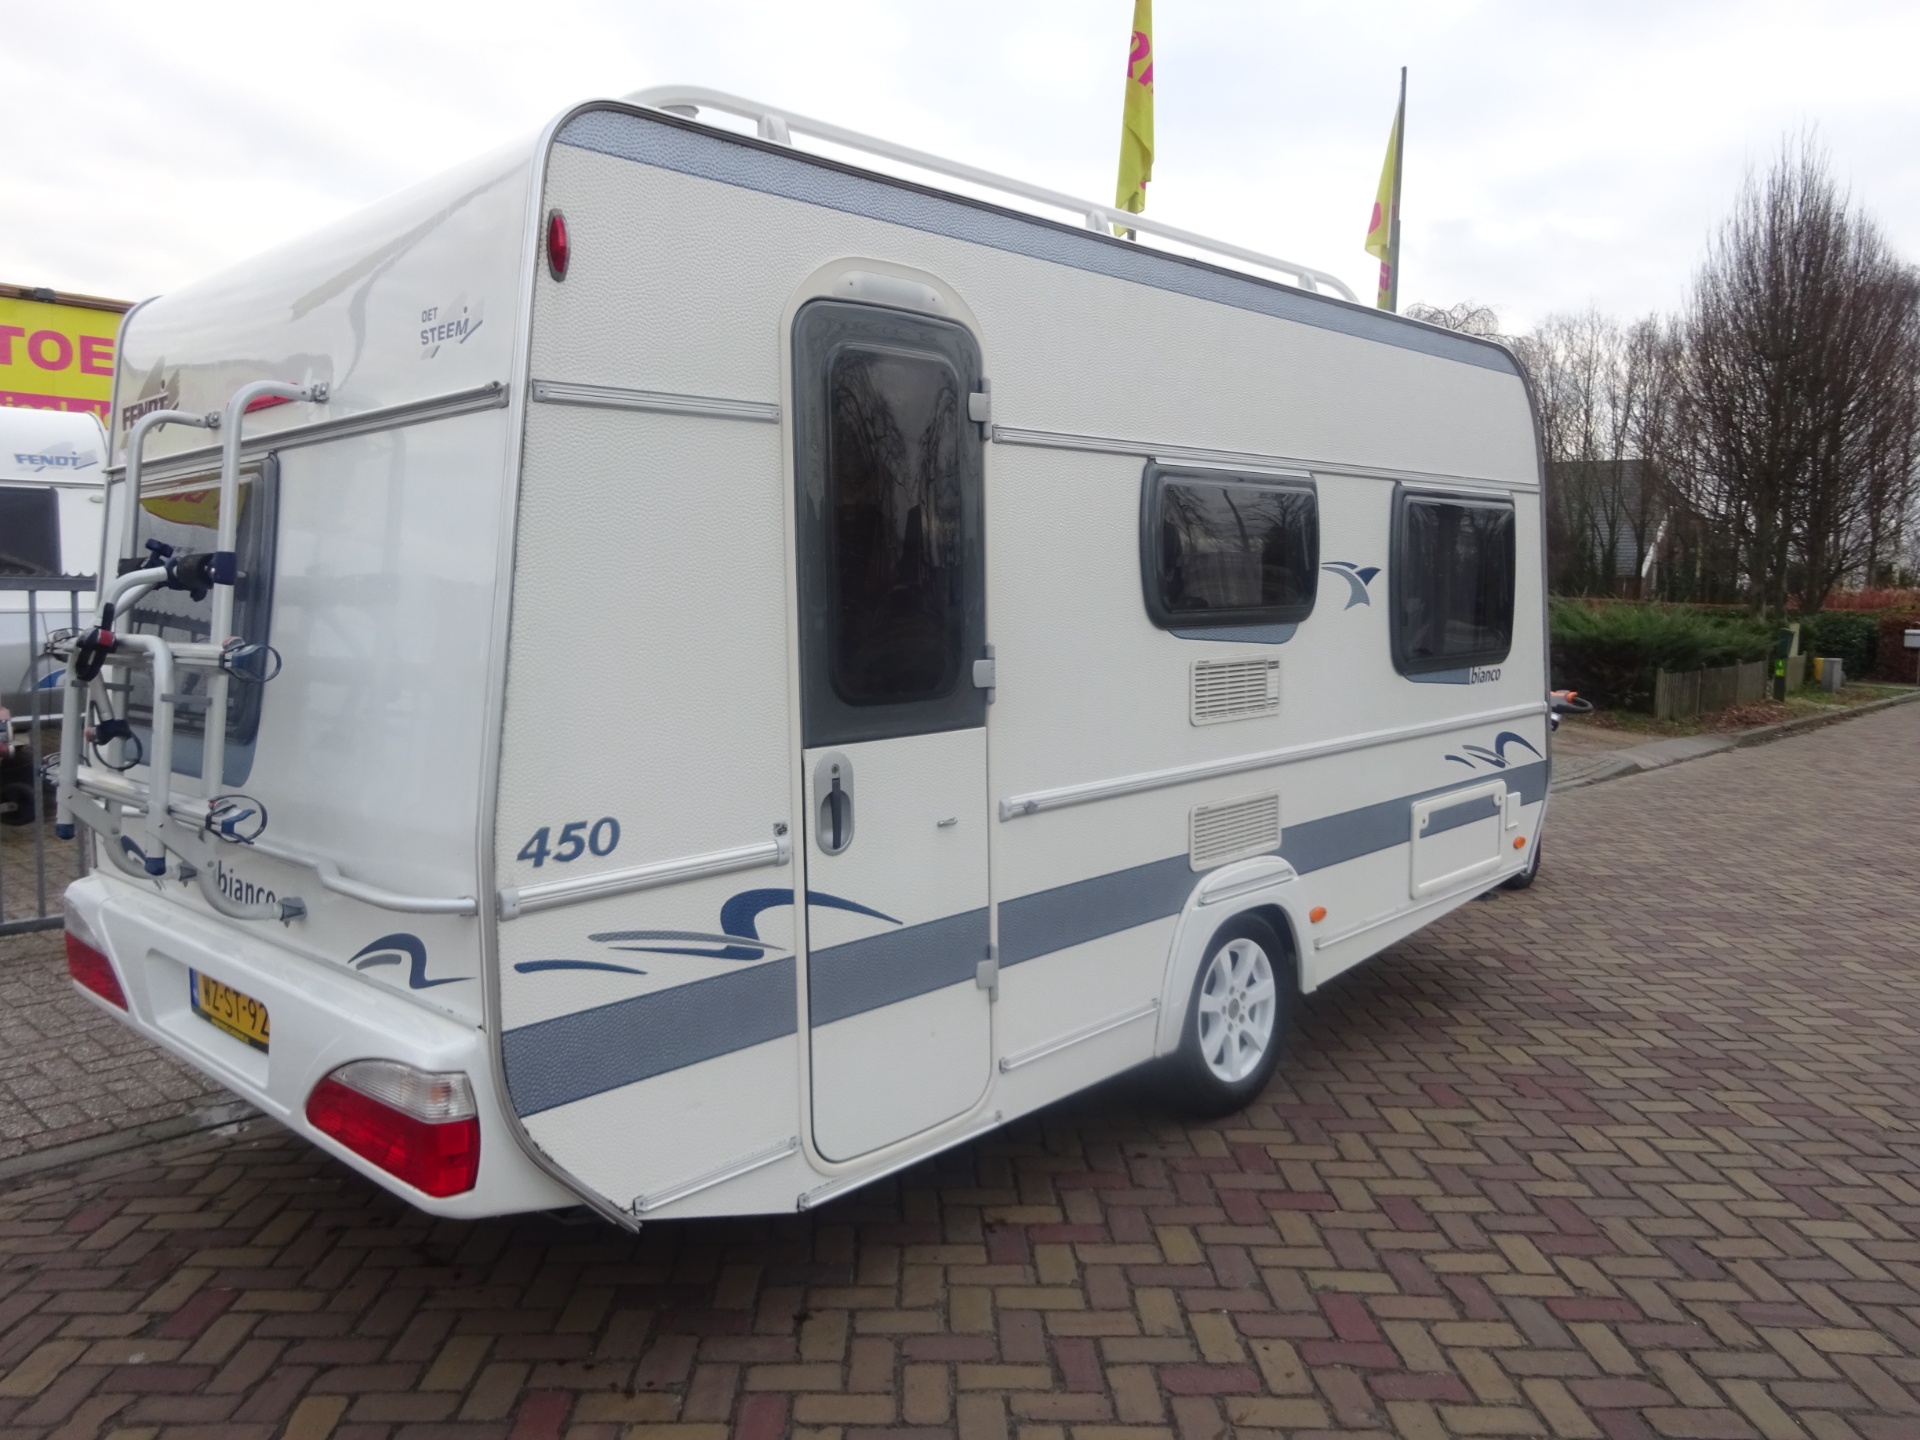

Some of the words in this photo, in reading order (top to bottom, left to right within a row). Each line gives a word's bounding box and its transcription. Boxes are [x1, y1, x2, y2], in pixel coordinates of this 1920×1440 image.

[422, 306, 438, 323] DET
[420, 317, 469, 345] STEEM
[14, 451, 81, 467] FENDT
[1470, 666, 1501, 684] bianco
[516, 816, 621, 868] 450
